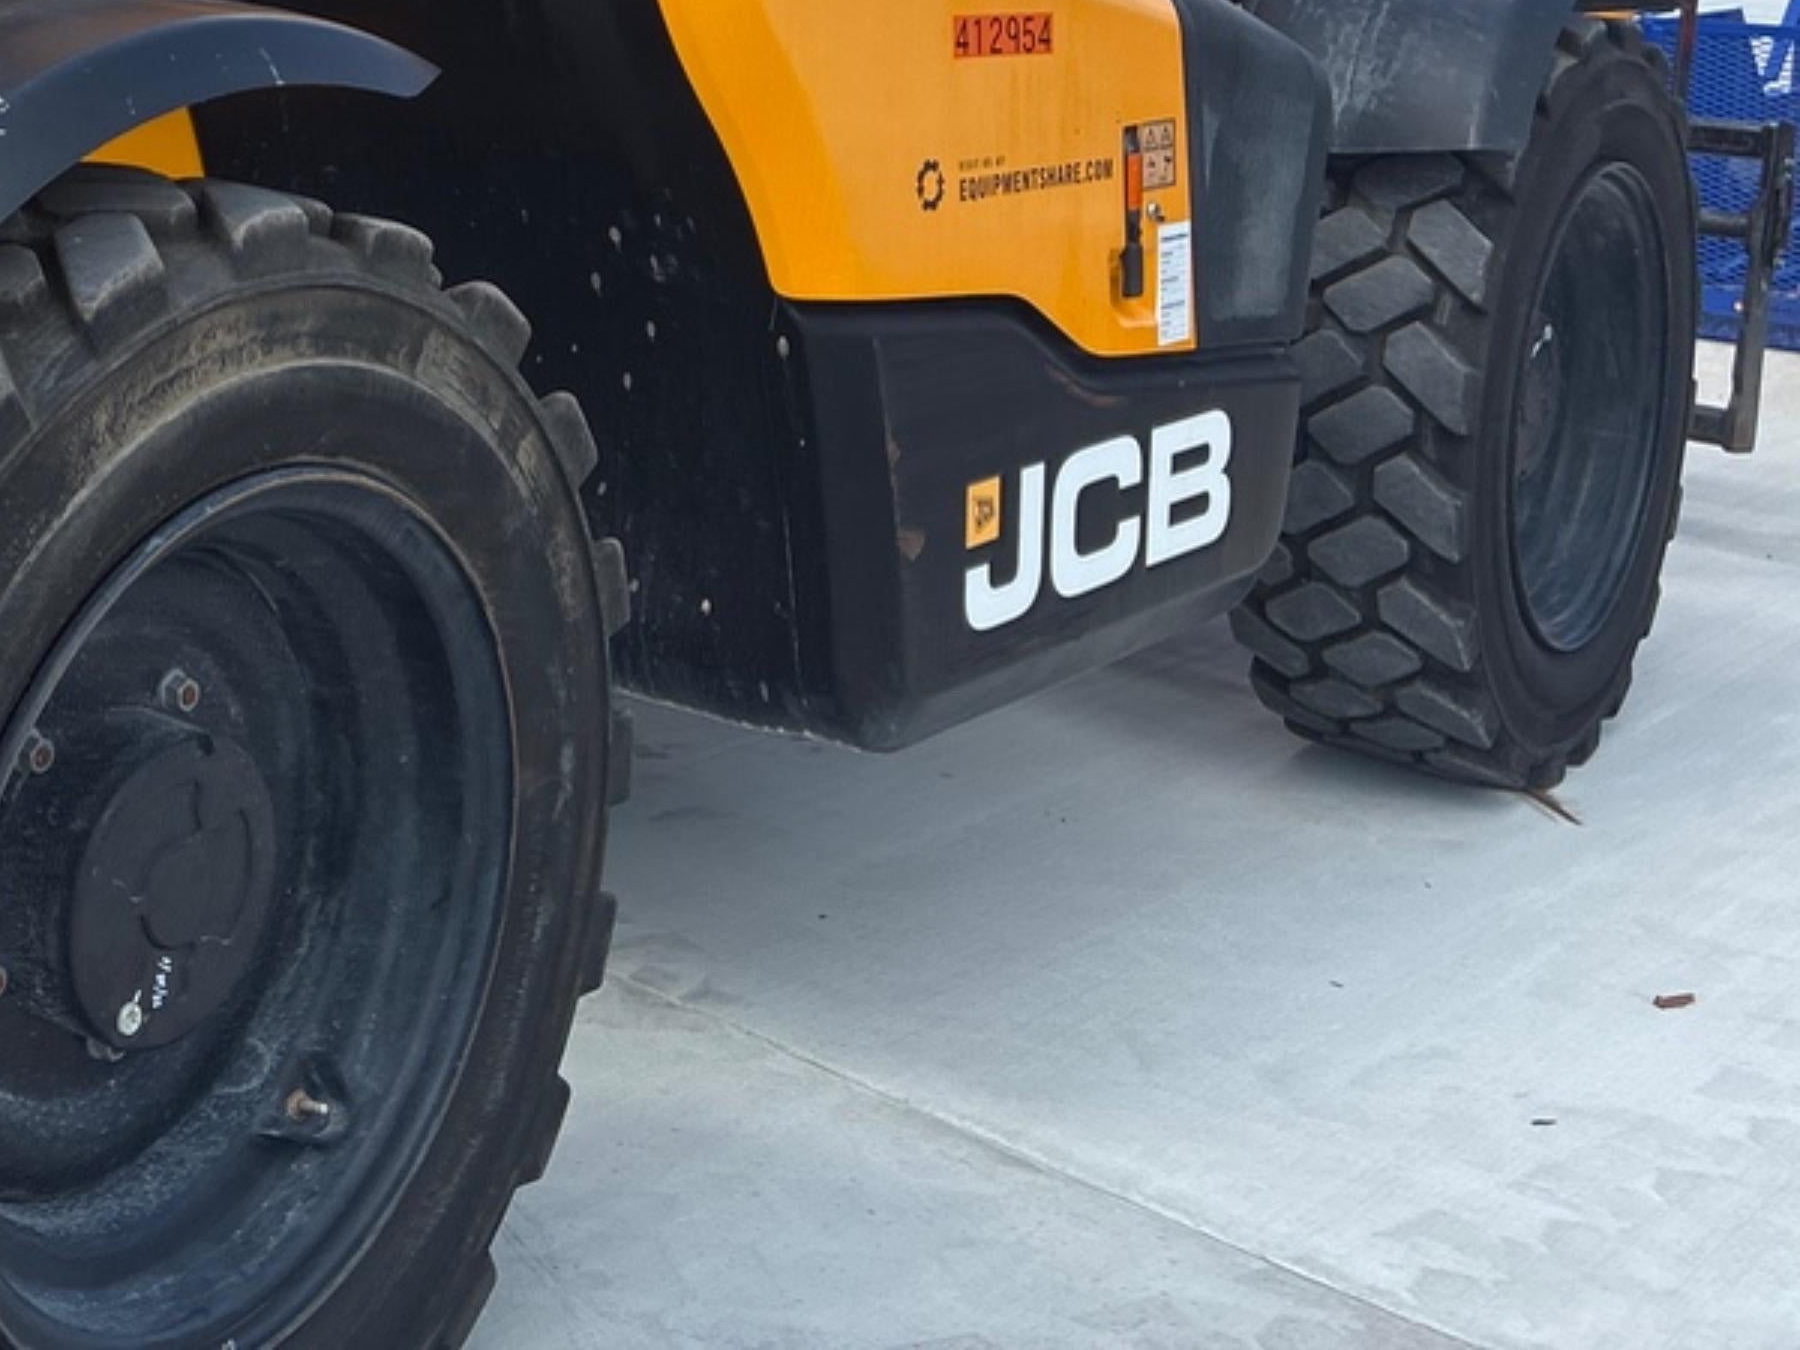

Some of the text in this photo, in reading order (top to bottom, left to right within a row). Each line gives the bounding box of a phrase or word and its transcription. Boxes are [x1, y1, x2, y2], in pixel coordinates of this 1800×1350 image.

[956, 15, 1051, 55] 412954
[959, 157, 1114, 202] EQUIPMENTSHARE.COM
[964, 408, 1232, 631] JCB
